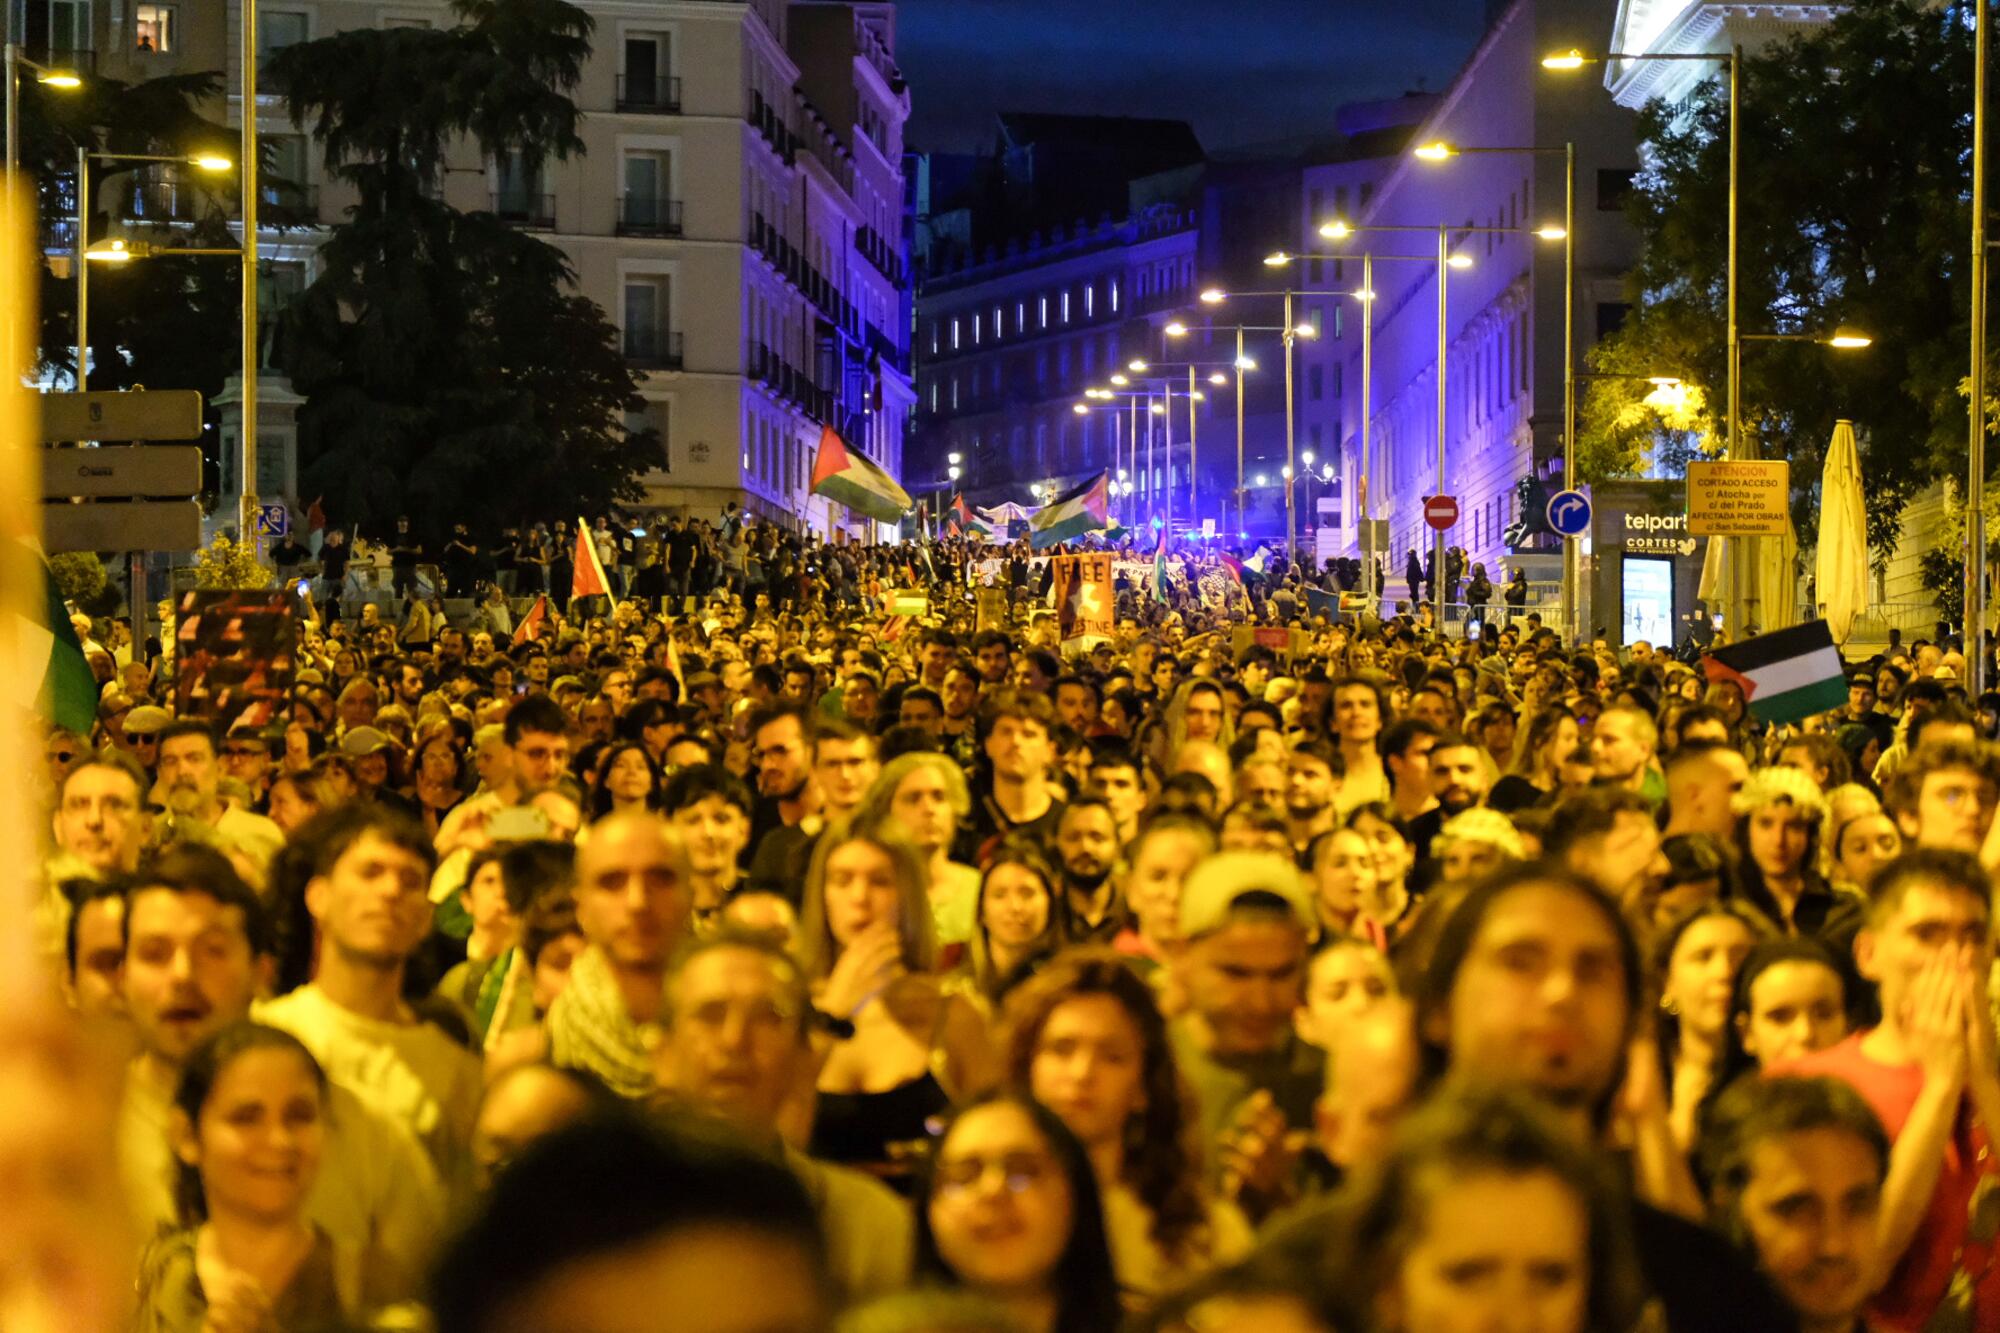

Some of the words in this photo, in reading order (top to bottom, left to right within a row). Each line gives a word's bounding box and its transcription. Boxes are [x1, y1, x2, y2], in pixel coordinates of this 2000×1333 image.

[1697, 479, 1740, 487] CORTADO
[1742, 479, 1778, 487] ACCESO
[1705, 490, 1715, 498] c/
[1717, 489, 1750, 498] Atocha
[1709, 501, 1717, 510] c/
[1720, 501, 1735, 509] del
[1738, 501, 1765, 509] Prado
[1692, 512, 1735, 520] AFECTADA
[1738, 512, 1755, 520] POR
[1757, 512, 1784, 520] OBRAS
[1626, 538, 1676, 547] CORTES
[1061, 562, 1104, 584] FEE
